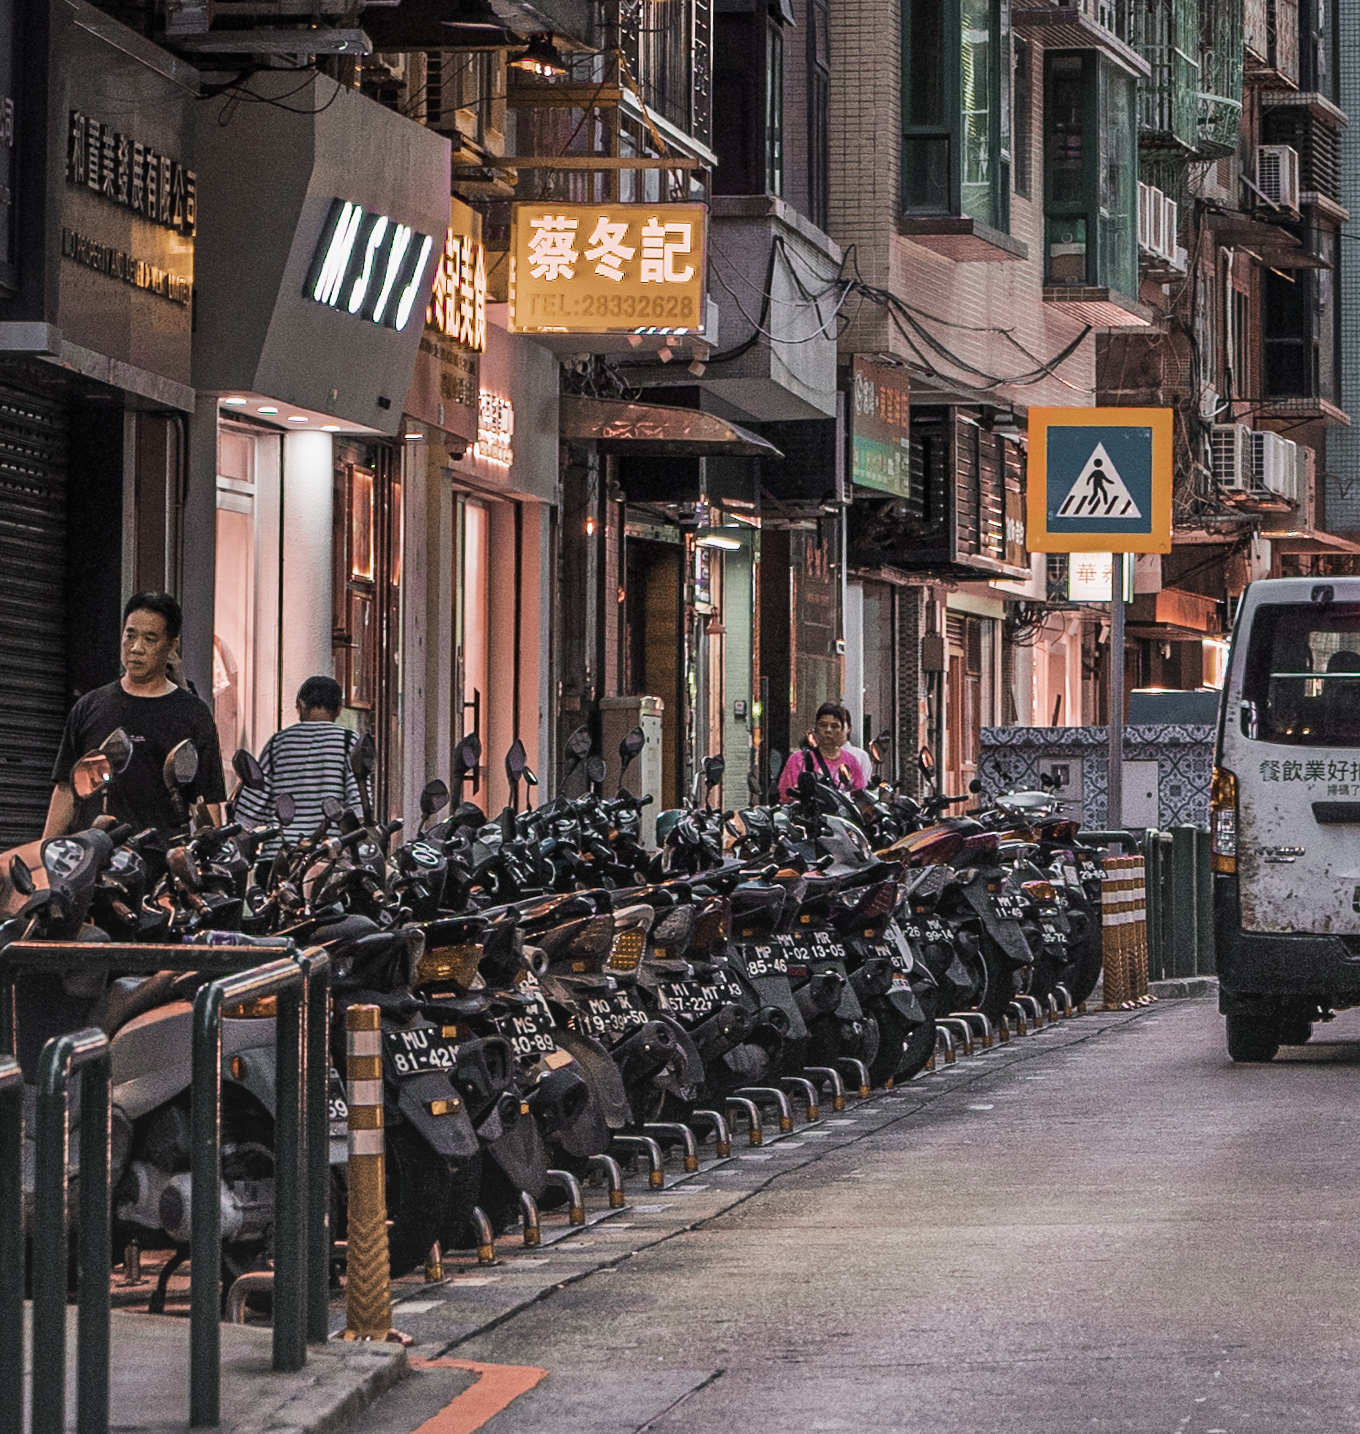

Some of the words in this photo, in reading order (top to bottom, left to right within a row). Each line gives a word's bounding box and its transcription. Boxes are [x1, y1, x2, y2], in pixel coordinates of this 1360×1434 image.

[65, 110, 197, 237] 和置業發展有限公司
[528, 214, 694, 283] 蔡冬記
[426, 227, 487, 353] 冬記美食
[528, 293, 693, 318] TEL:28332628
[755, 945, 772, 959] MP
[811, 944, 845, 958] 13-05
[749, 958, 788, 973] 85-46
[512, 1016, 537, 1034] MS
[404, 1030, 429, 1050] MU
[394, 1047, 453, 1072] 81-42
